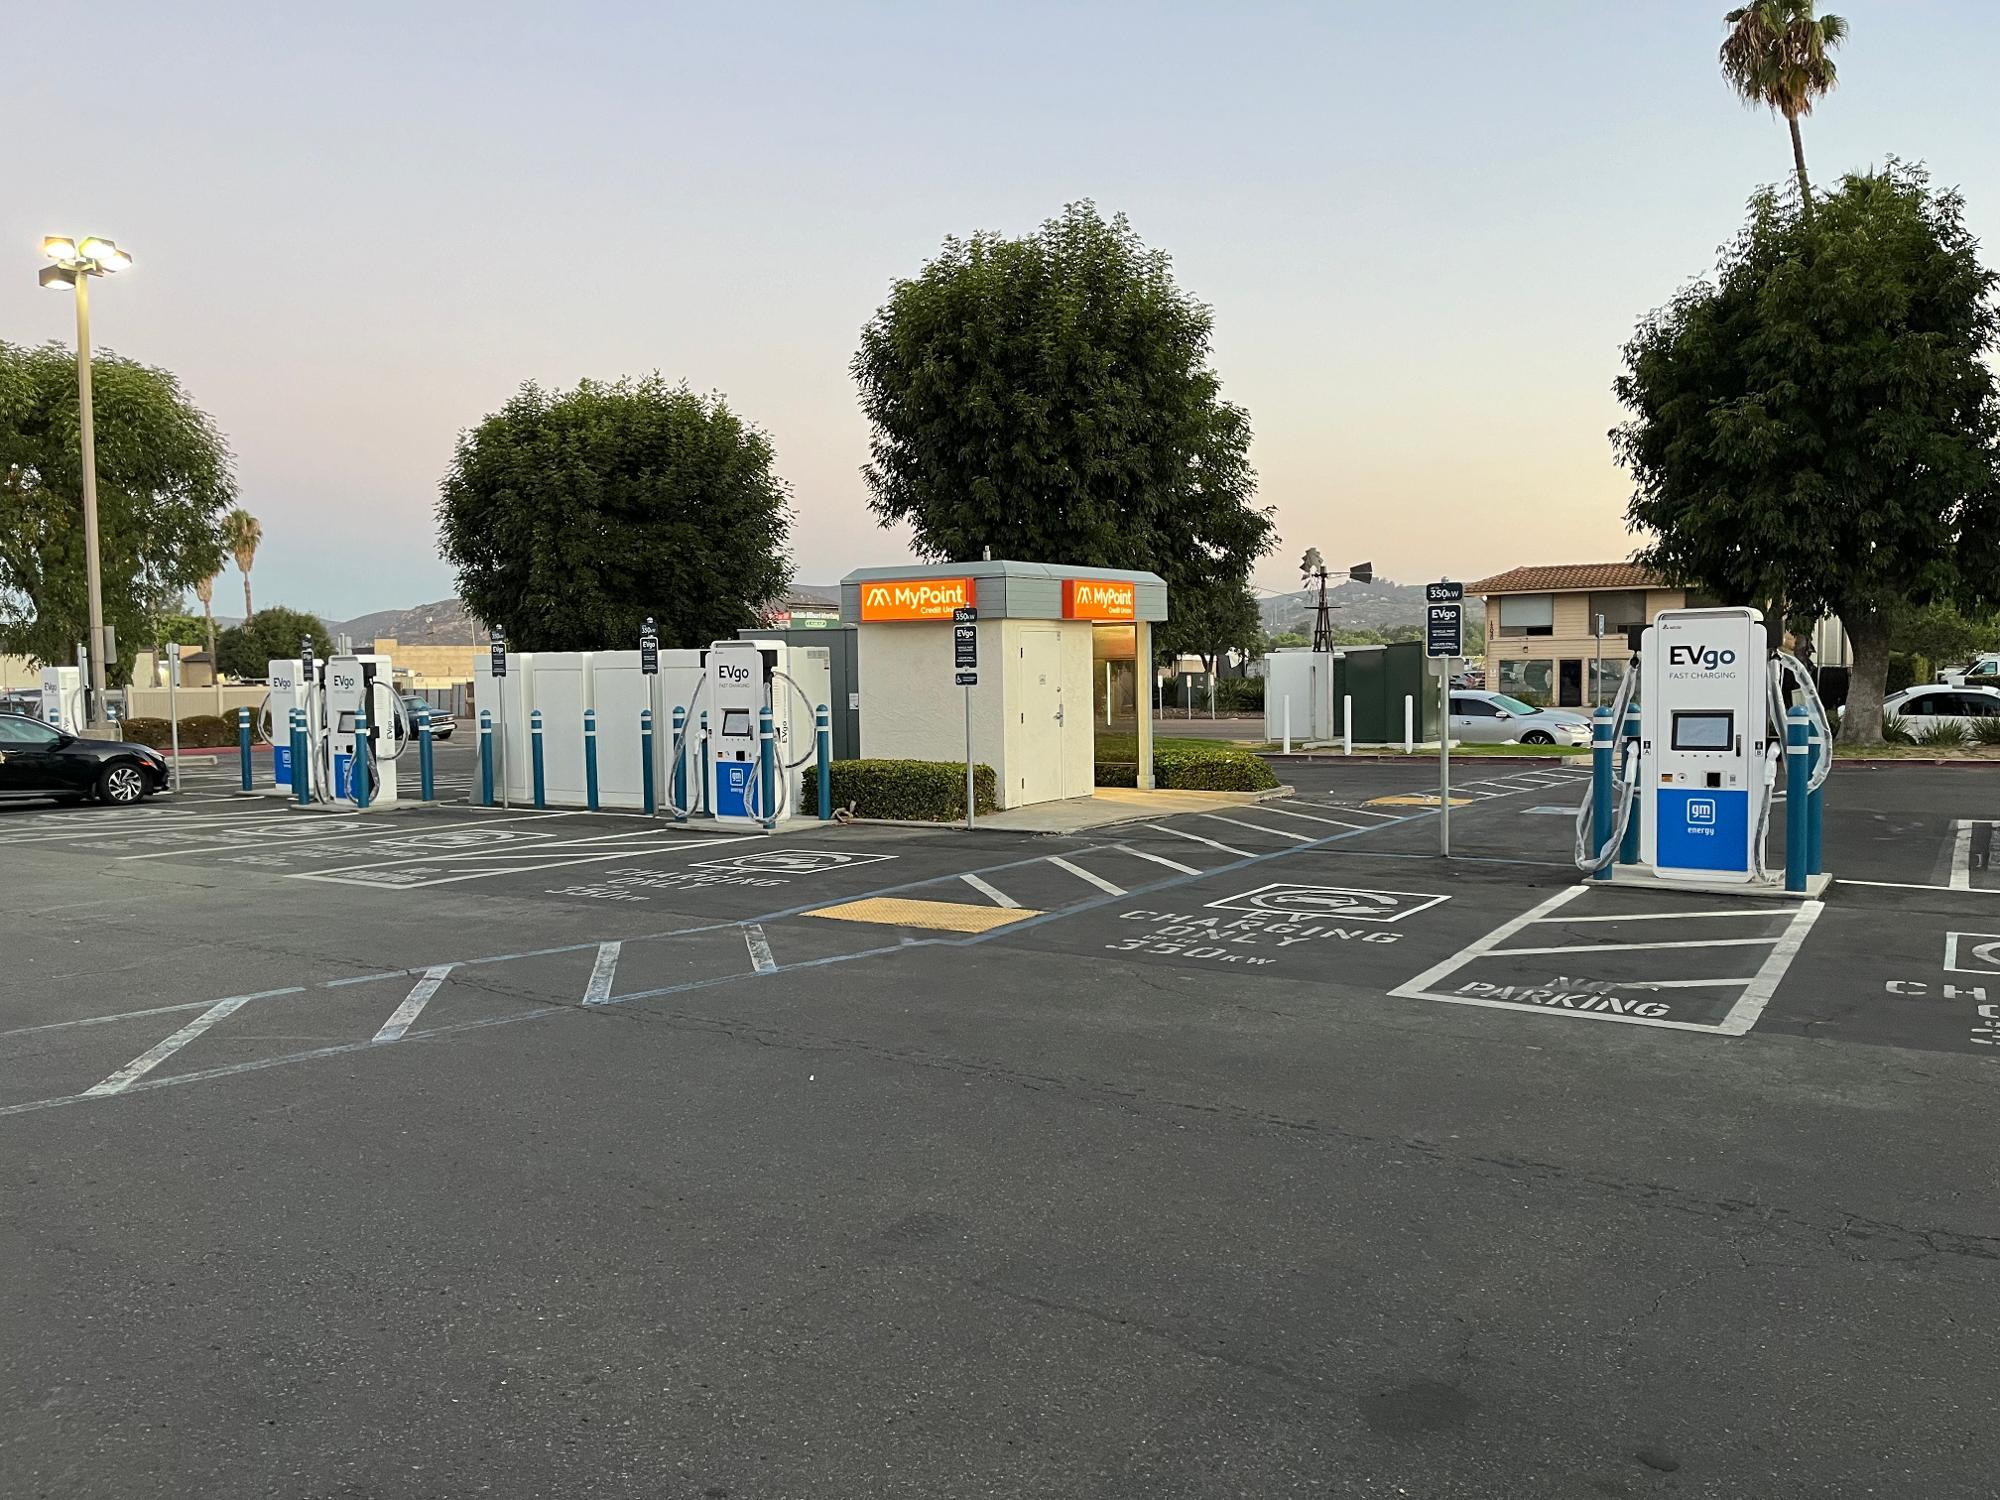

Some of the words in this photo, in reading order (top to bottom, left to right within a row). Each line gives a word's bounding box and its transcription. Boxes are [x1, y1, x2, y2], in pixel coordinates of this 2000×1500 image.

[895, 585, 963, 609] MyPoint
[1094, 587, 1132, 608] MyPoint
[1430, 589, 1459, 598] 350kW
[920, 606, 942, 614] Credit
[1431, 609, 1457, 620] EVgo
[957, 629, 974, 639] EVgo
[1669, 645, 1736, 671] EVgo
[718, 665, 749, 682] EVgo
[1669, 672, 1689, 680] FAST
[1690, 671, 1736, 680] CHARGING
[274, 677, 291, 689] EVgo
[333, 675, 355, 689] EVgo
[1691, 804, 1711, 819] gm
[1687, 826, 1715, 836] energy
[1119, 910, 1404, 943] CHARGING
[1155, 925, 1311, 947] ONLY
[1453, 981, 1672, 1017] PARKING
